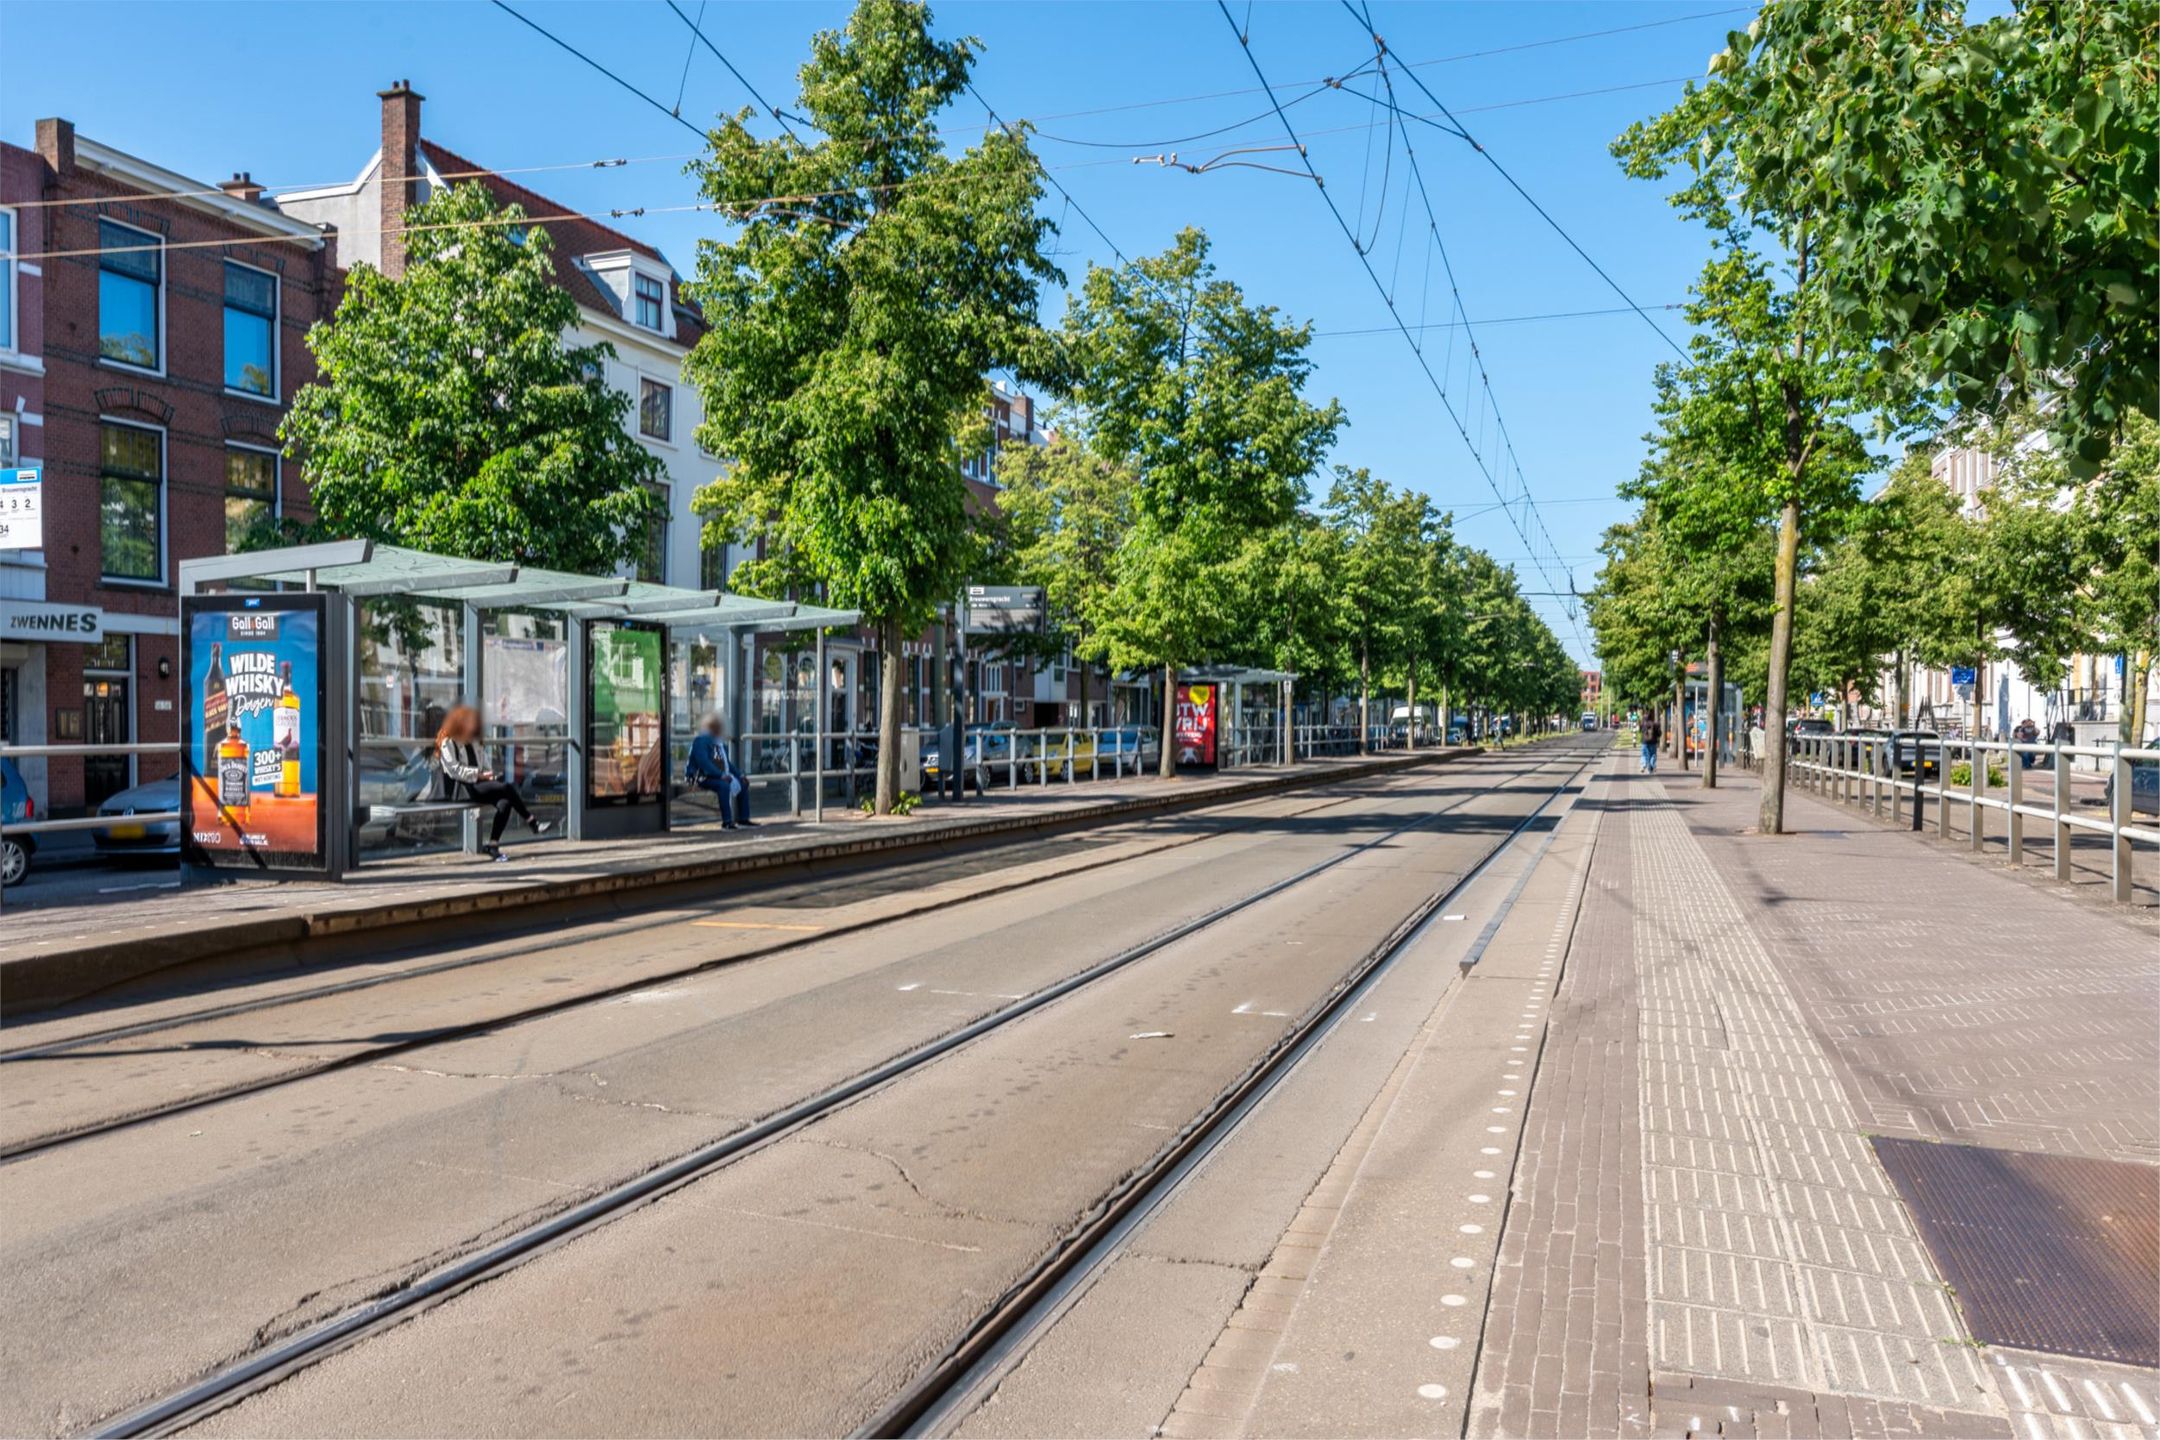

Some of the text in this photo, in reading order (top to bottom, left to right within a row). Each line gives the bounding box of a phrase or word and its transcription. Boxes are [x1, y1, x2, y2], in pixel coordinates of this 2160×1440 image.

[11, 499, 17, 509] 3
[25, 499, 31, 508] 2
[10, 612, 97, 633] ZWENNES
[232, 616, 251, 630] Gall
[255, 616, 275, 630] Gall
[230, 653, 276, 675] WILDE
[225, 673, 284, 697] WHISKY
[235, 695, 274, 718] Dagen
[254, 749, 282, 766] 300+
